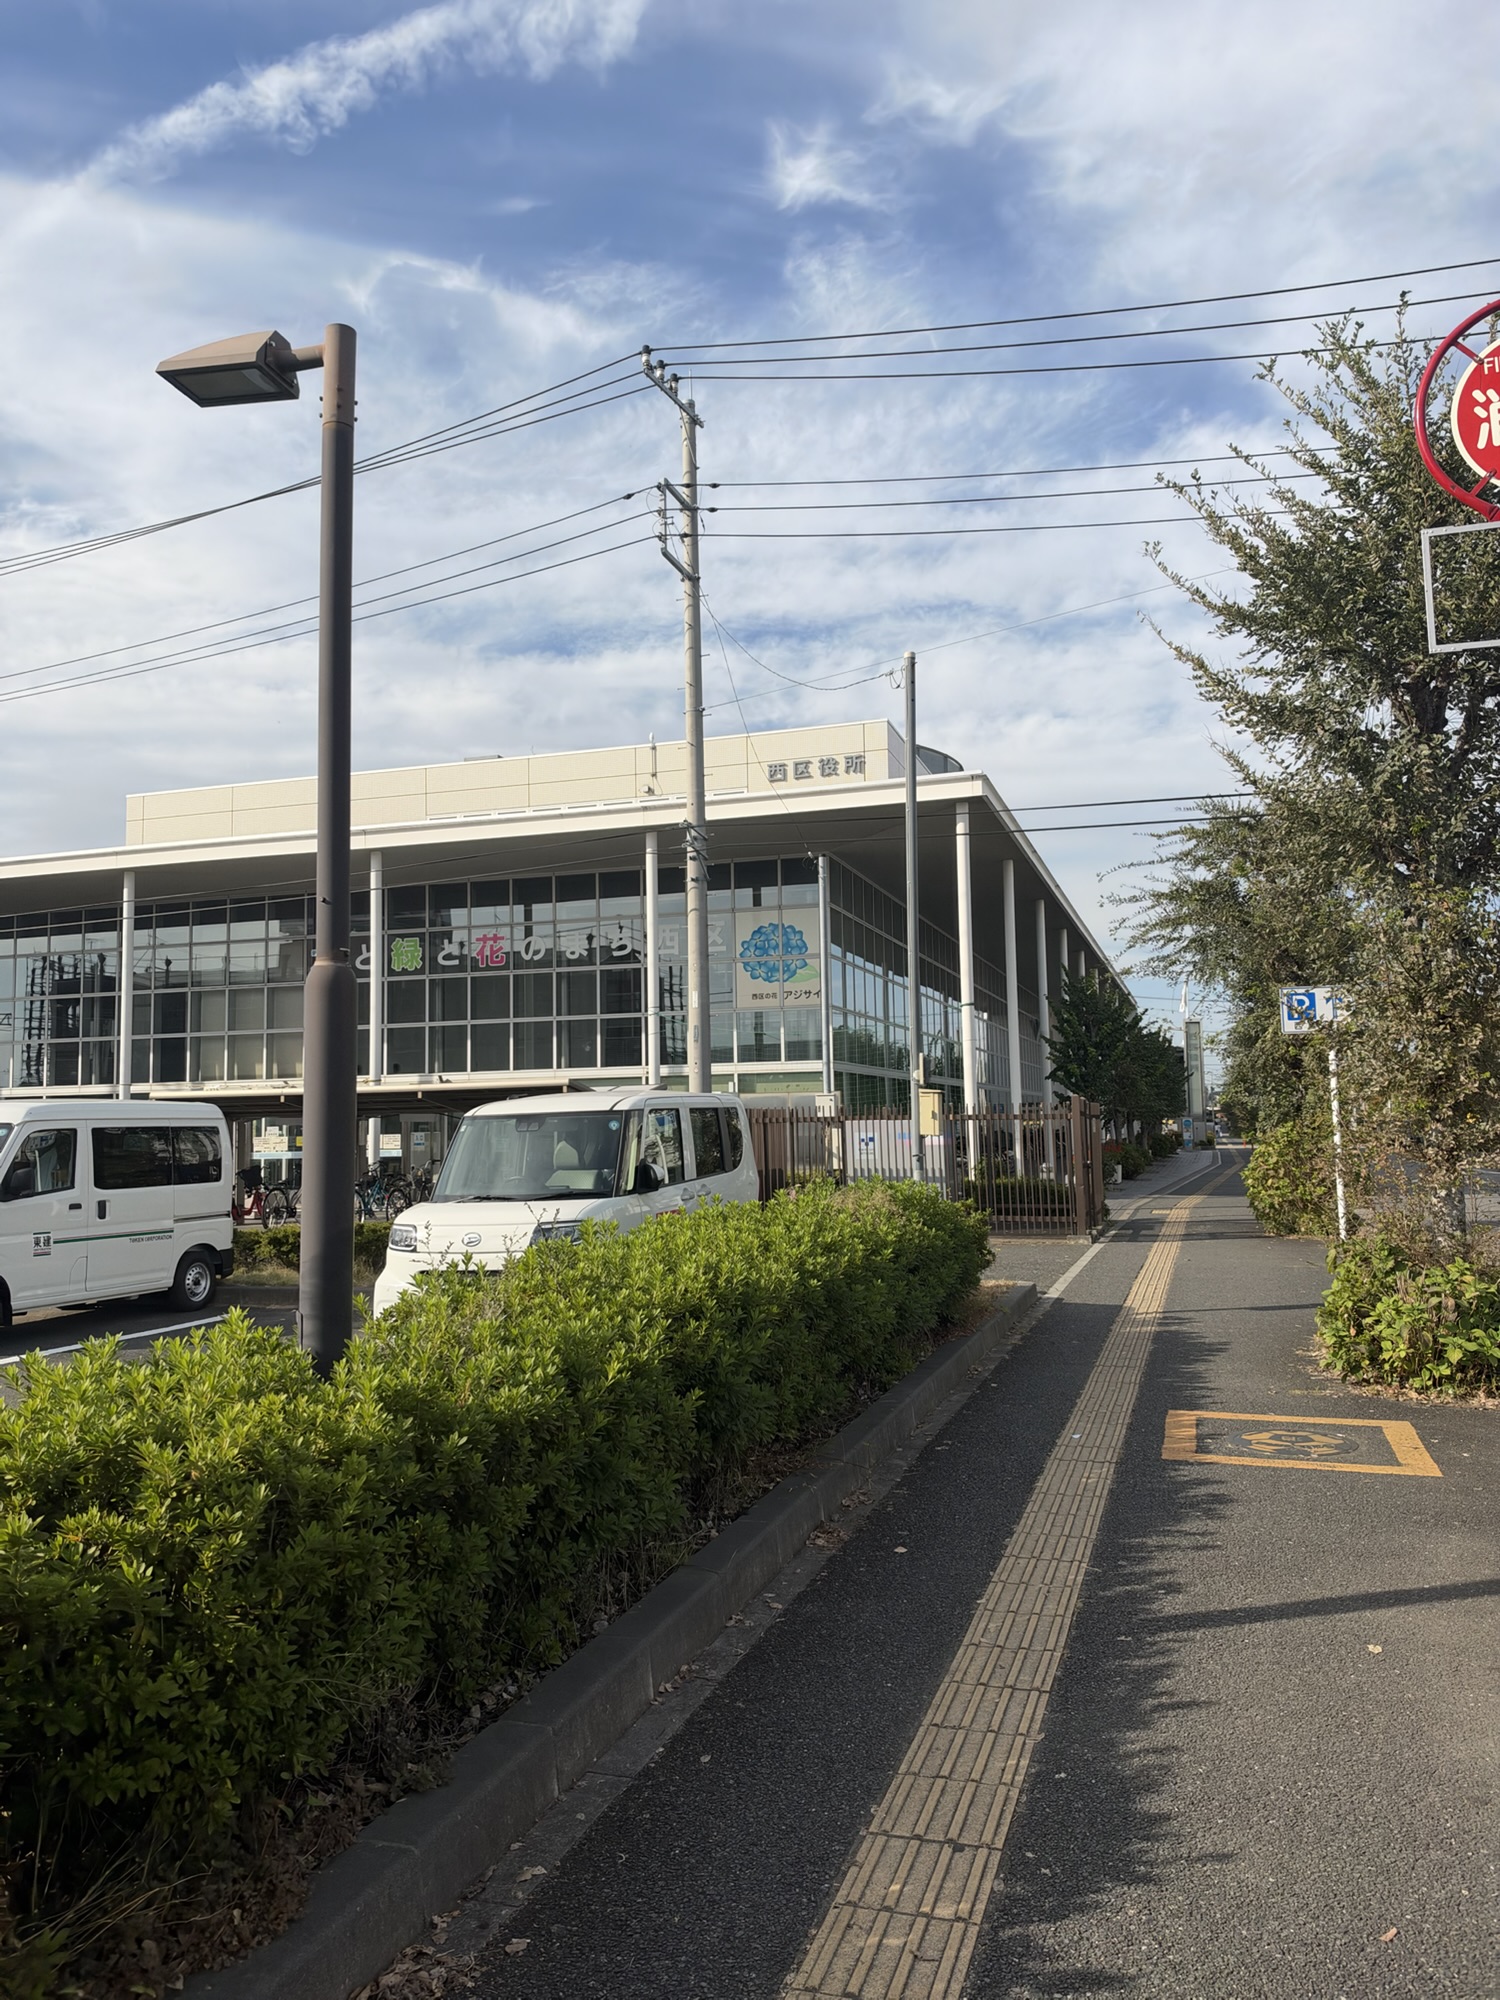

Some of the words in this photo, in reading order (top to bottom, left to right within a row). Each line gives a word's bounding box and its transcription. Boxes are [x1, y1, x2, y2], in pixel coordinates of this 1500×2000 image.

[767, 754, 866, 782] 西区役所
[784, 989, 821, 1000] アジサイ
[33, 1236, 51, 1248] 東建
